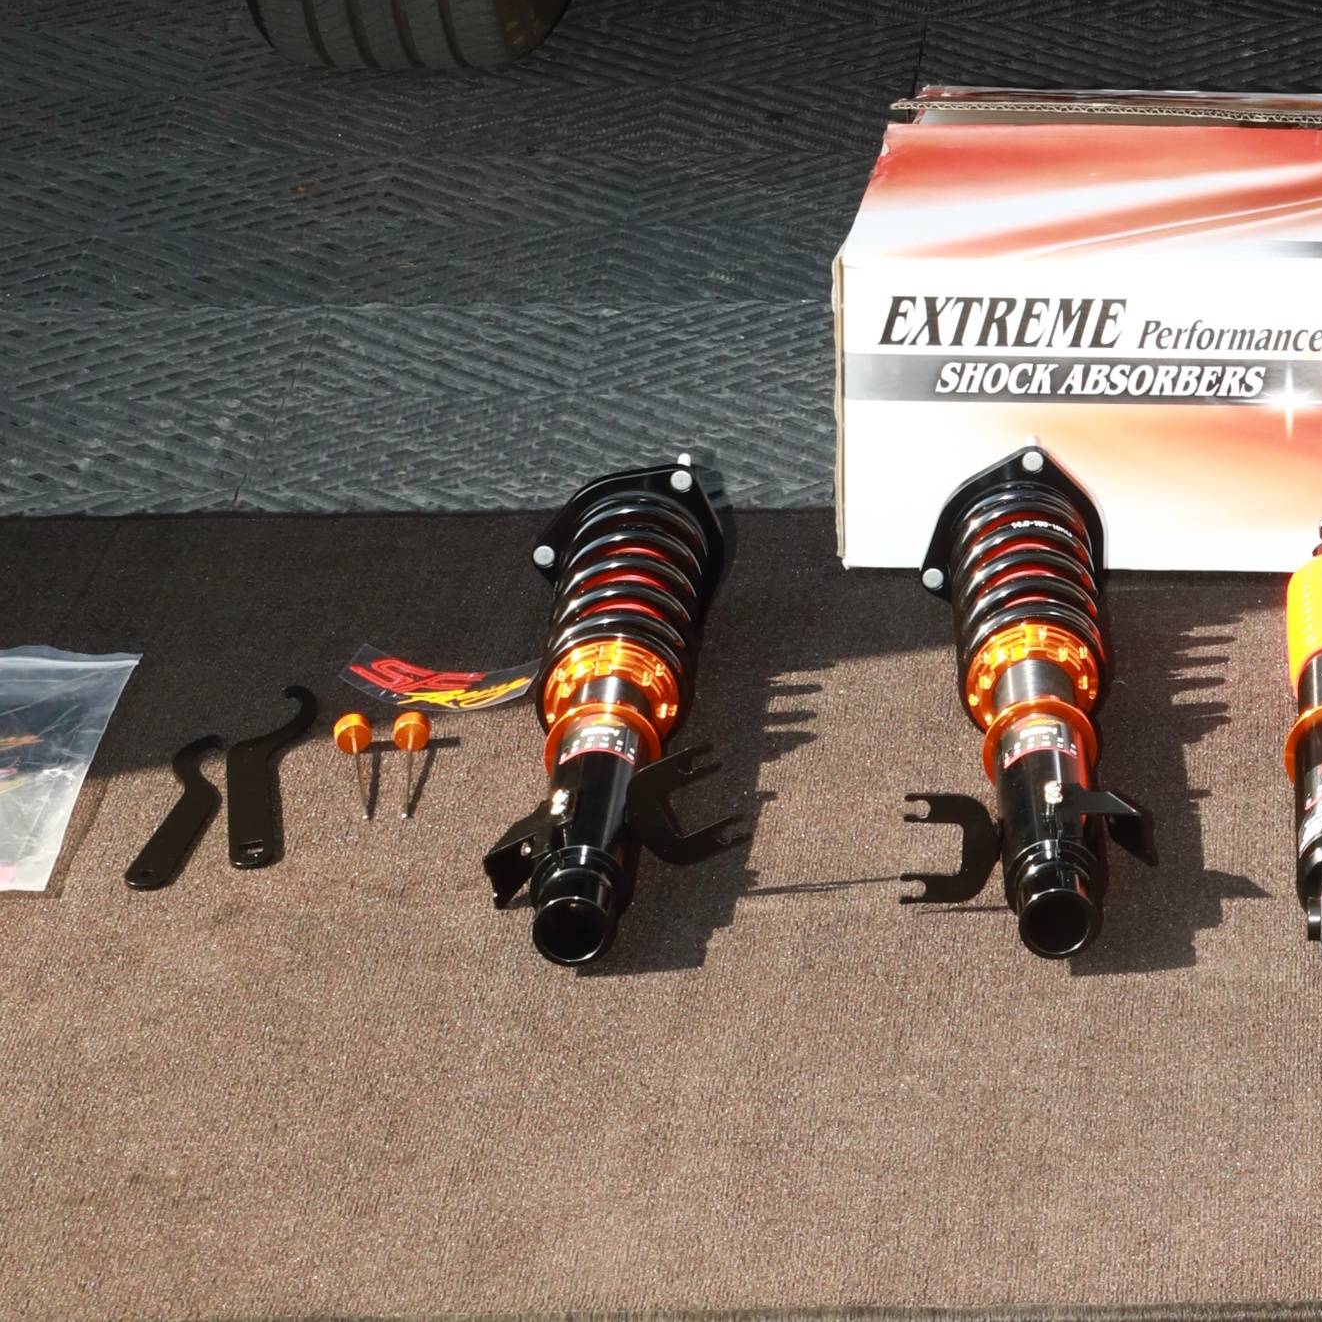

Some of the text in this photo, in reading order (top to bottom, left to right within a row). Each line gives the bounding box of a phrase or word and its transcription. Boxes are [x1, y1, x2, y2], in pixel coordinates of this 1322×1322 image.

[877, 295, 1128, 349] EXTREME
[935, 362, 1266, 398] SHOCK ABSORBERS
